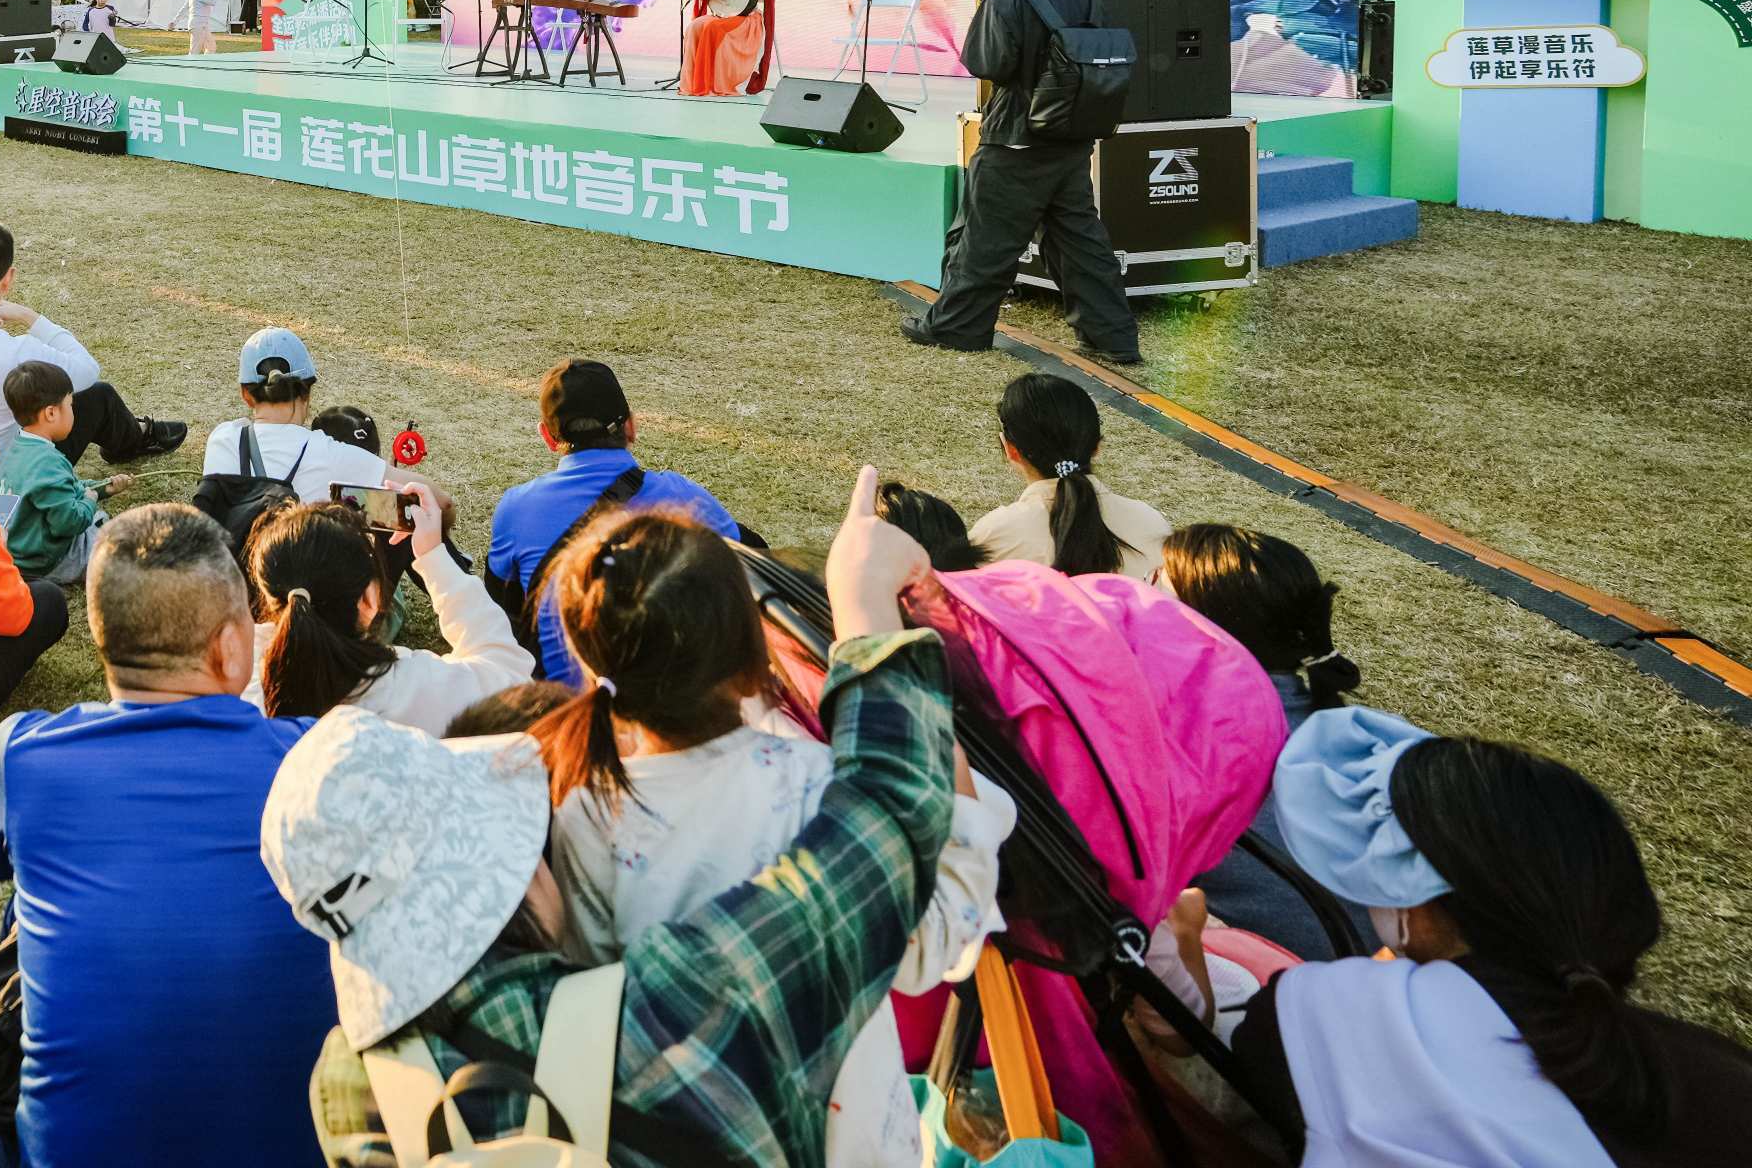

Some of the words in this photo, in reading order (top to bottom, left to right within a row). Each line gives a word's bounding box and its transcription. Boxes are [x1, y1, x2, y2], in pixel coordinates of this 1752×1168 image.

[1467, 34, 1594, 56] 莲草漫音乐
[1469, 59, 1596, 79] 伊起享乐符
[29, 86, 119, 126] 星空音乐会
[127, 95, 282, 163] 第十一届
[299, 116, 790, 235] 莲花山草地音乐节
[1149, 184, 1199, 198] ZSOUND
